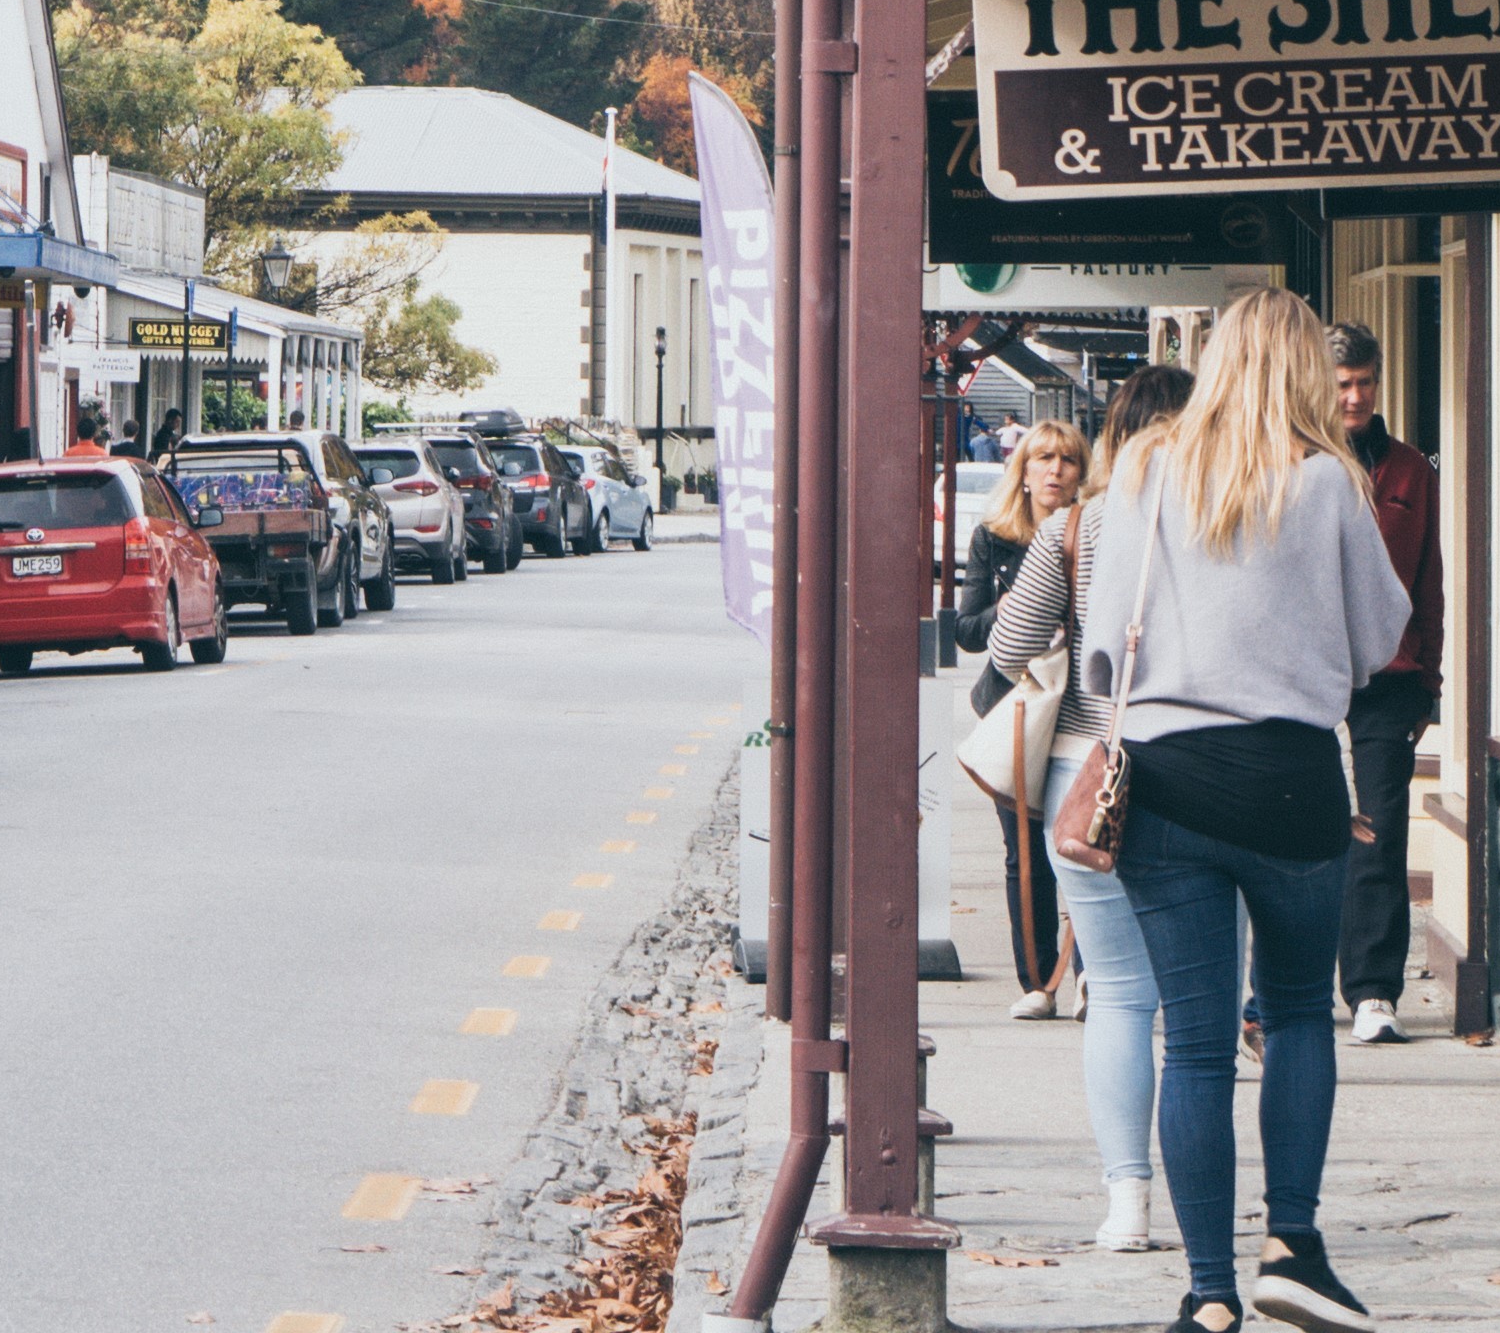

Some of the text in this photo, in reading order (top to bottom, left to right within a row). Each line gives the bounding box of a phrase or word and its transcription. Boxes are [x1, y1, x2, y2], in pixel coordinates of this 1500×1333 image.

[1106, 63, 1489, 123] ICE CREAM
[1054, 128, 1101, 175] &
[991, 235, 1040, 244] FEATURING
[1042, 235, 1068, 243] WINES
[1070, 235, 1081, 243] BY
[1129, 234, 1157, 243] VALLEY
[136, 323, 169, 336] GOLD
[141, 336, 163, 345] GIFTS
[14, 556, 62, 574] JME259
